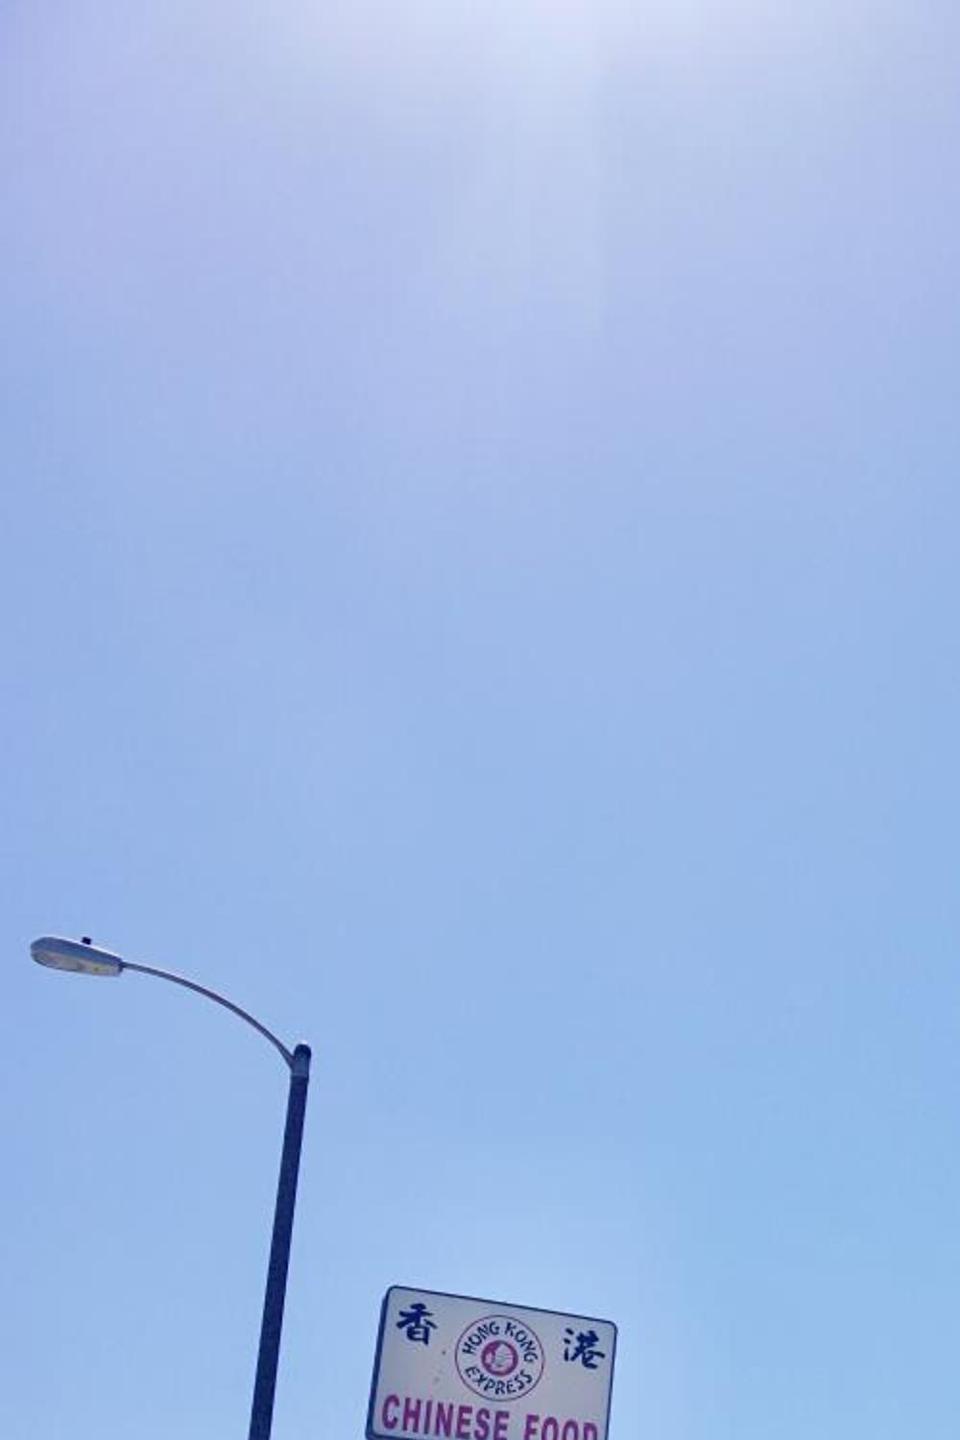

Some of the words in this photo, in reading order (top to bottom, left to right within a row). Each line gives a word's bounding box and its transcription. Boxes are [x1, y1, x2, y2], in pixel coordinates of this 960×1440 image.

[396, 1303, 438, 1346] 香
[563, 1327, 606, 1370] 港
[462, 1320, 501, 1356] HONG
[504, 1321, 539, 1364] KONG
[465, 1364, 533, 1395] EXPRESS
